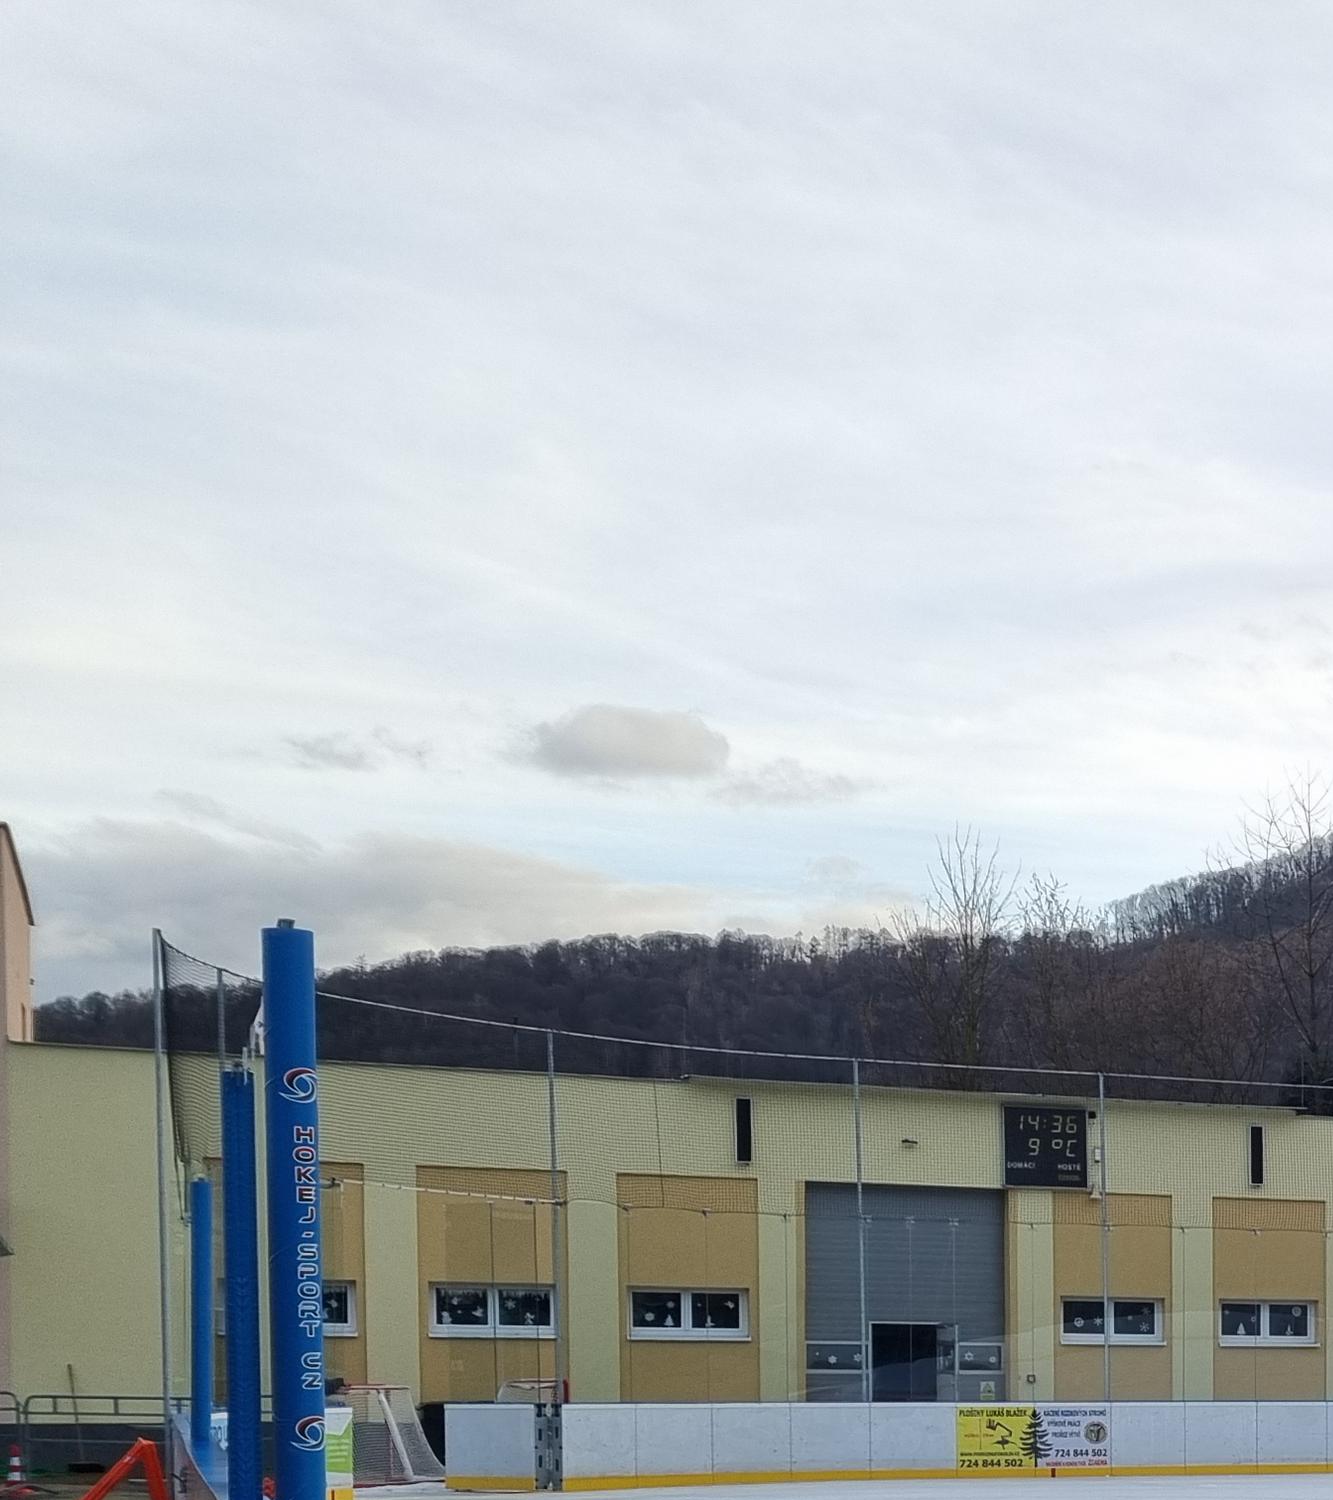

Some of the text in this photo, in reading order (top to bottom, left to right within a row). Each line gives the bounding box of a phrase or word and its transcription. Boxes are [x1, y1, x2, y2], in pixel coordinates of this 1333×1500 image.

[1019, 1115, 1077, 1133] 14:36
[1028, 1138, 1077, 1157] 9 °C
[1054, 1448, 1108, 1458] 724 844 502
[959, 1458, 1024, 1468] 724 844 502
